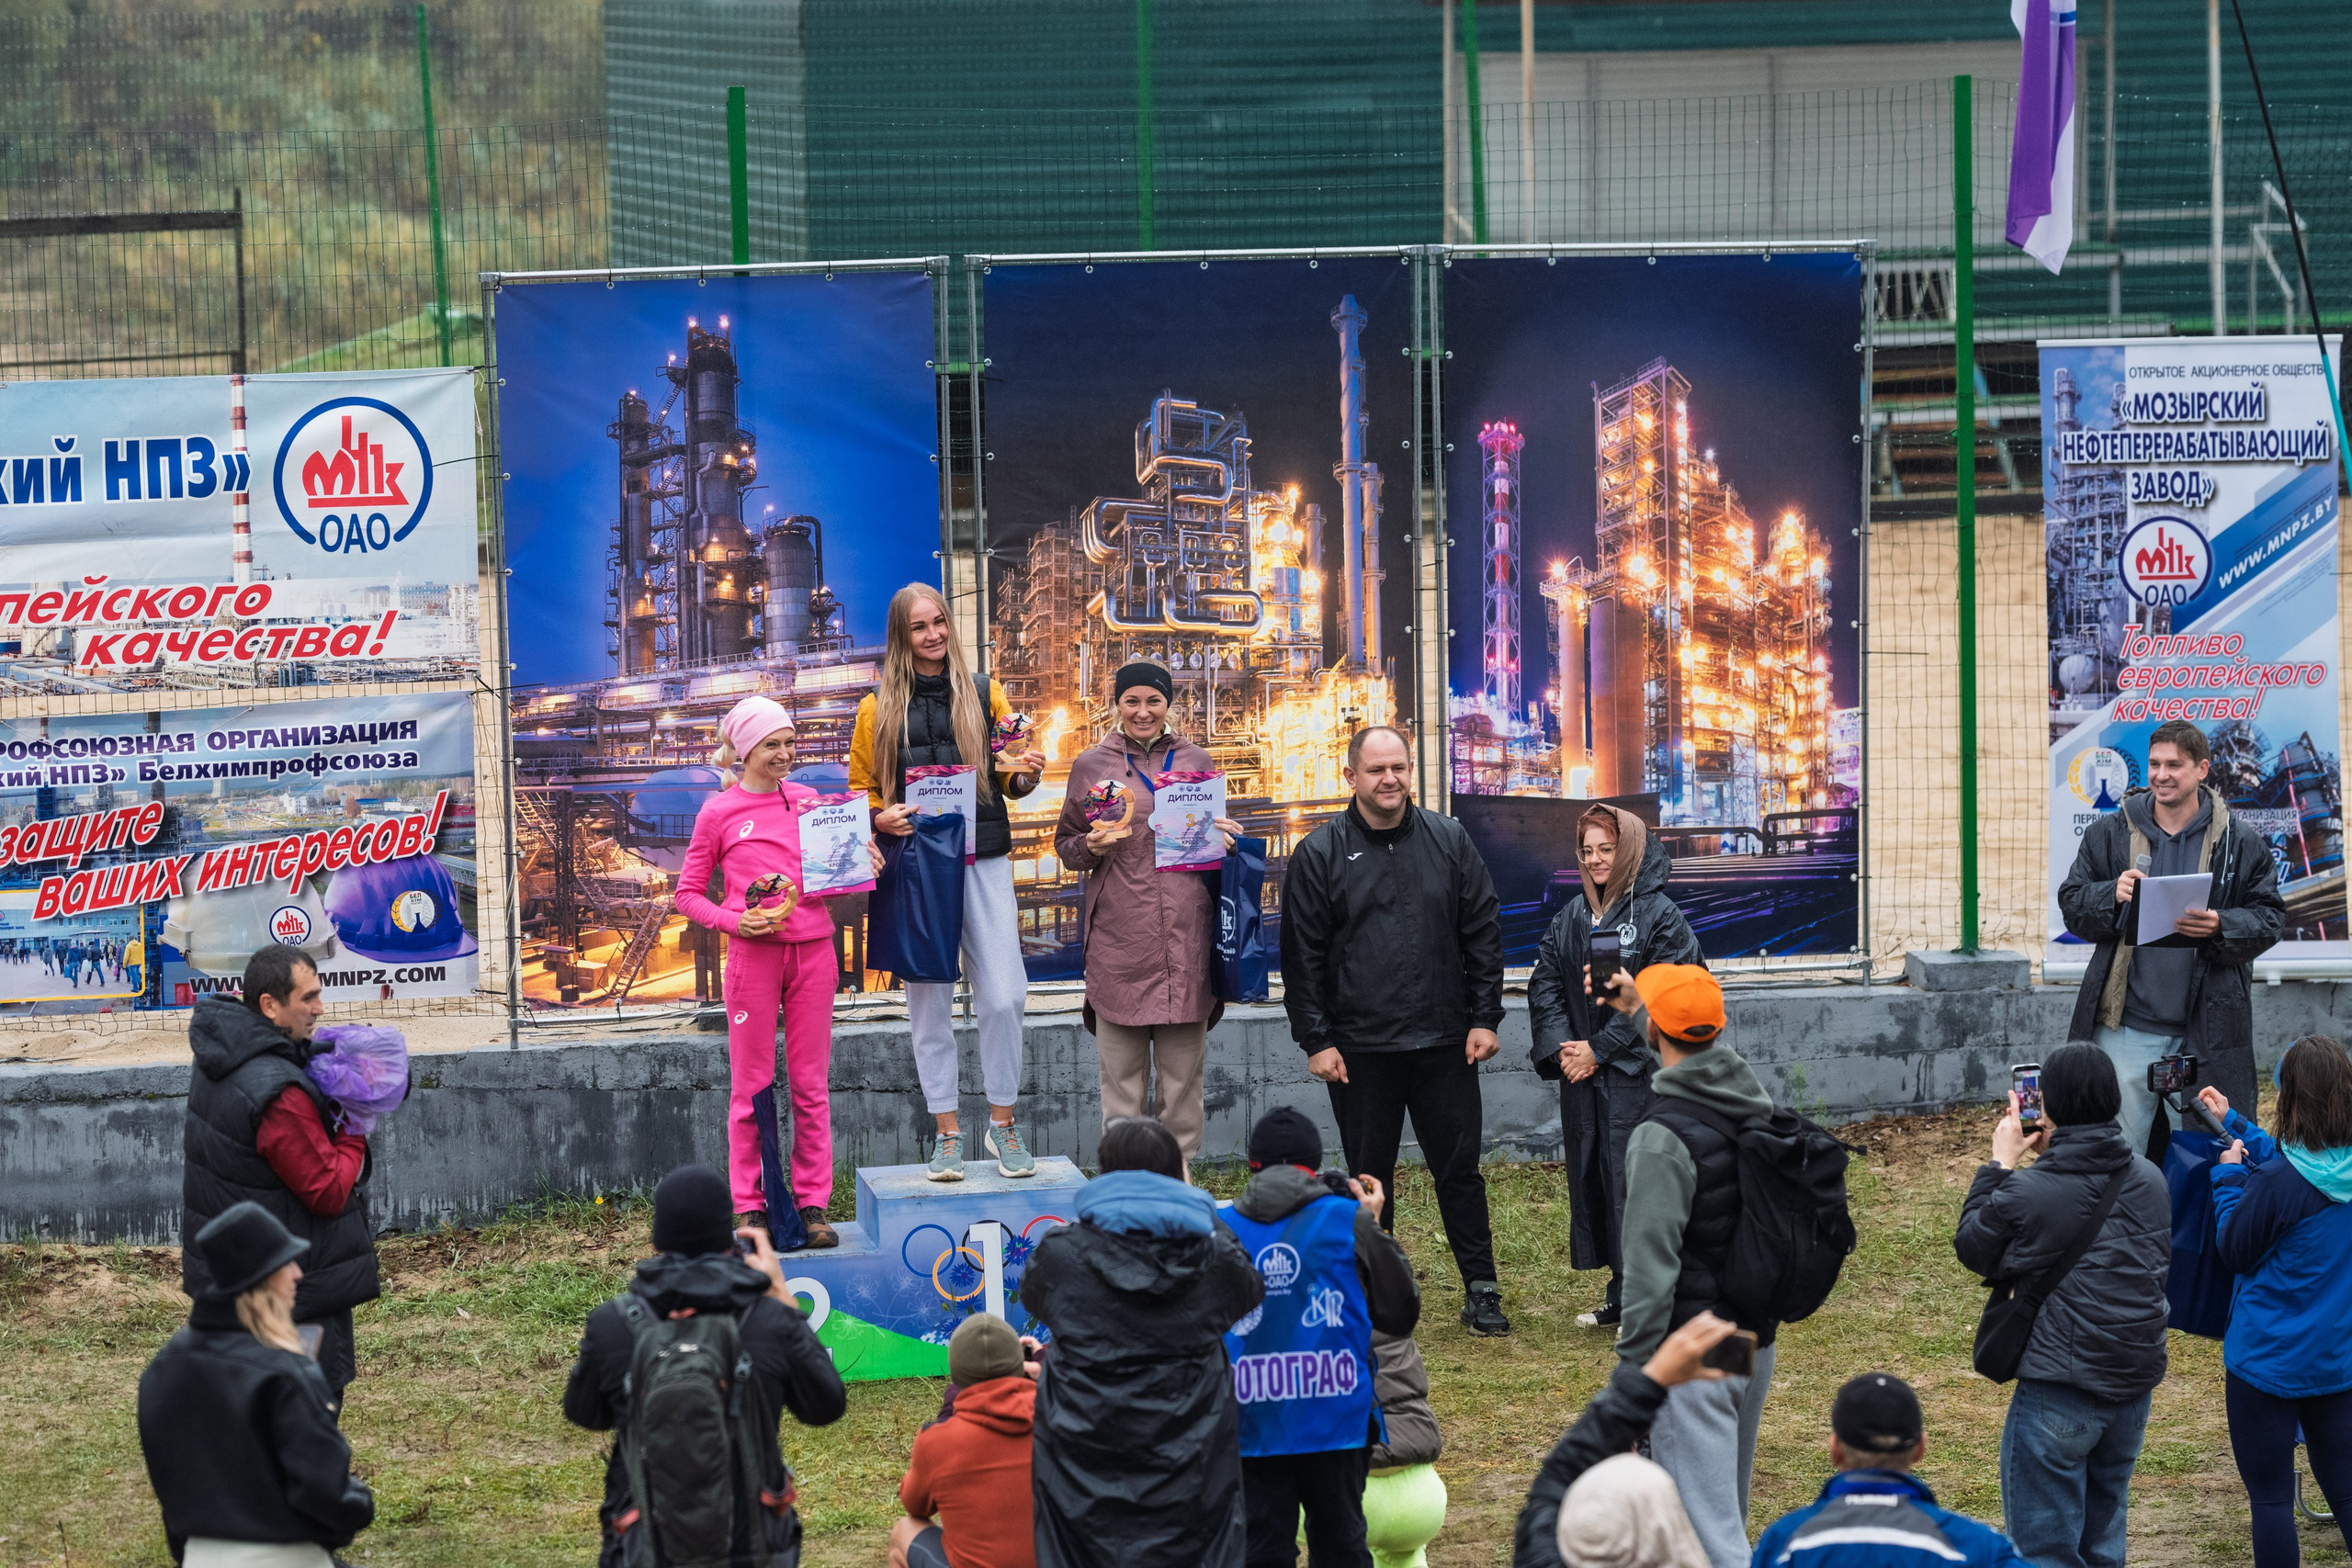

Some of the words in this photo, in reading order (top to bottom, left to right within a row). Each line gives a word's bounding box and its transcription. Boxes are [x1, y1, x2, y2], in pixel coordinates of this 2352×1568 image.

[2129, 366, 2186, 378] ОТКРЫТОЕ
[2191, 364, 2270, 379] АКЦИОНЕРНОЕ
[2272, 364, 2326, 378] ОБЩЕСТВ
[2121, 381, 2263, 420] «МОЗЫРСКИЙ
[2063, 420, 2328, 463] НЕФТЕПЕРЕРАБАТЫВАЮЩИЙ
[105, 435, 251, 502] НПЗ»
[2131, 470, 2213, 505] ЗАВОД»
[320, 513, 390, 554] ОАО
[2218, 495, 2334, 590] WWW.MNPZ.BY
[2145, 584, 2188, 606] ОАО
[81, 610, 399, 666] качества!
[2120, 625, 2244, 659] Топливо
[2118, 657, 2325, 698] европейского
[2113, 686, 2265, 721] качества!
[207, 719, 418, 750] ОРГАНИЗАЦИЯ
[50, 763, 126, 785] НПЗ»
[139, 750, 418, 781] Белхимпрофсоюза
[917, 787, 963, 796] ДИПЛОМ
[1167, 794, 1213, 803] ДИПЛОМ
[811, 815, 856, 827] ДИПЛОМ
[1185, 813, 1195, 828] 3
[33, 854, 191, 919] ваших
[198, 791, 447, 895] интересов!
[831, 835, 841, 851] 2
[969, 1222, 1006, 1321] 1
[1234, 1352, 1355, 1400] ОТОГРАФ
